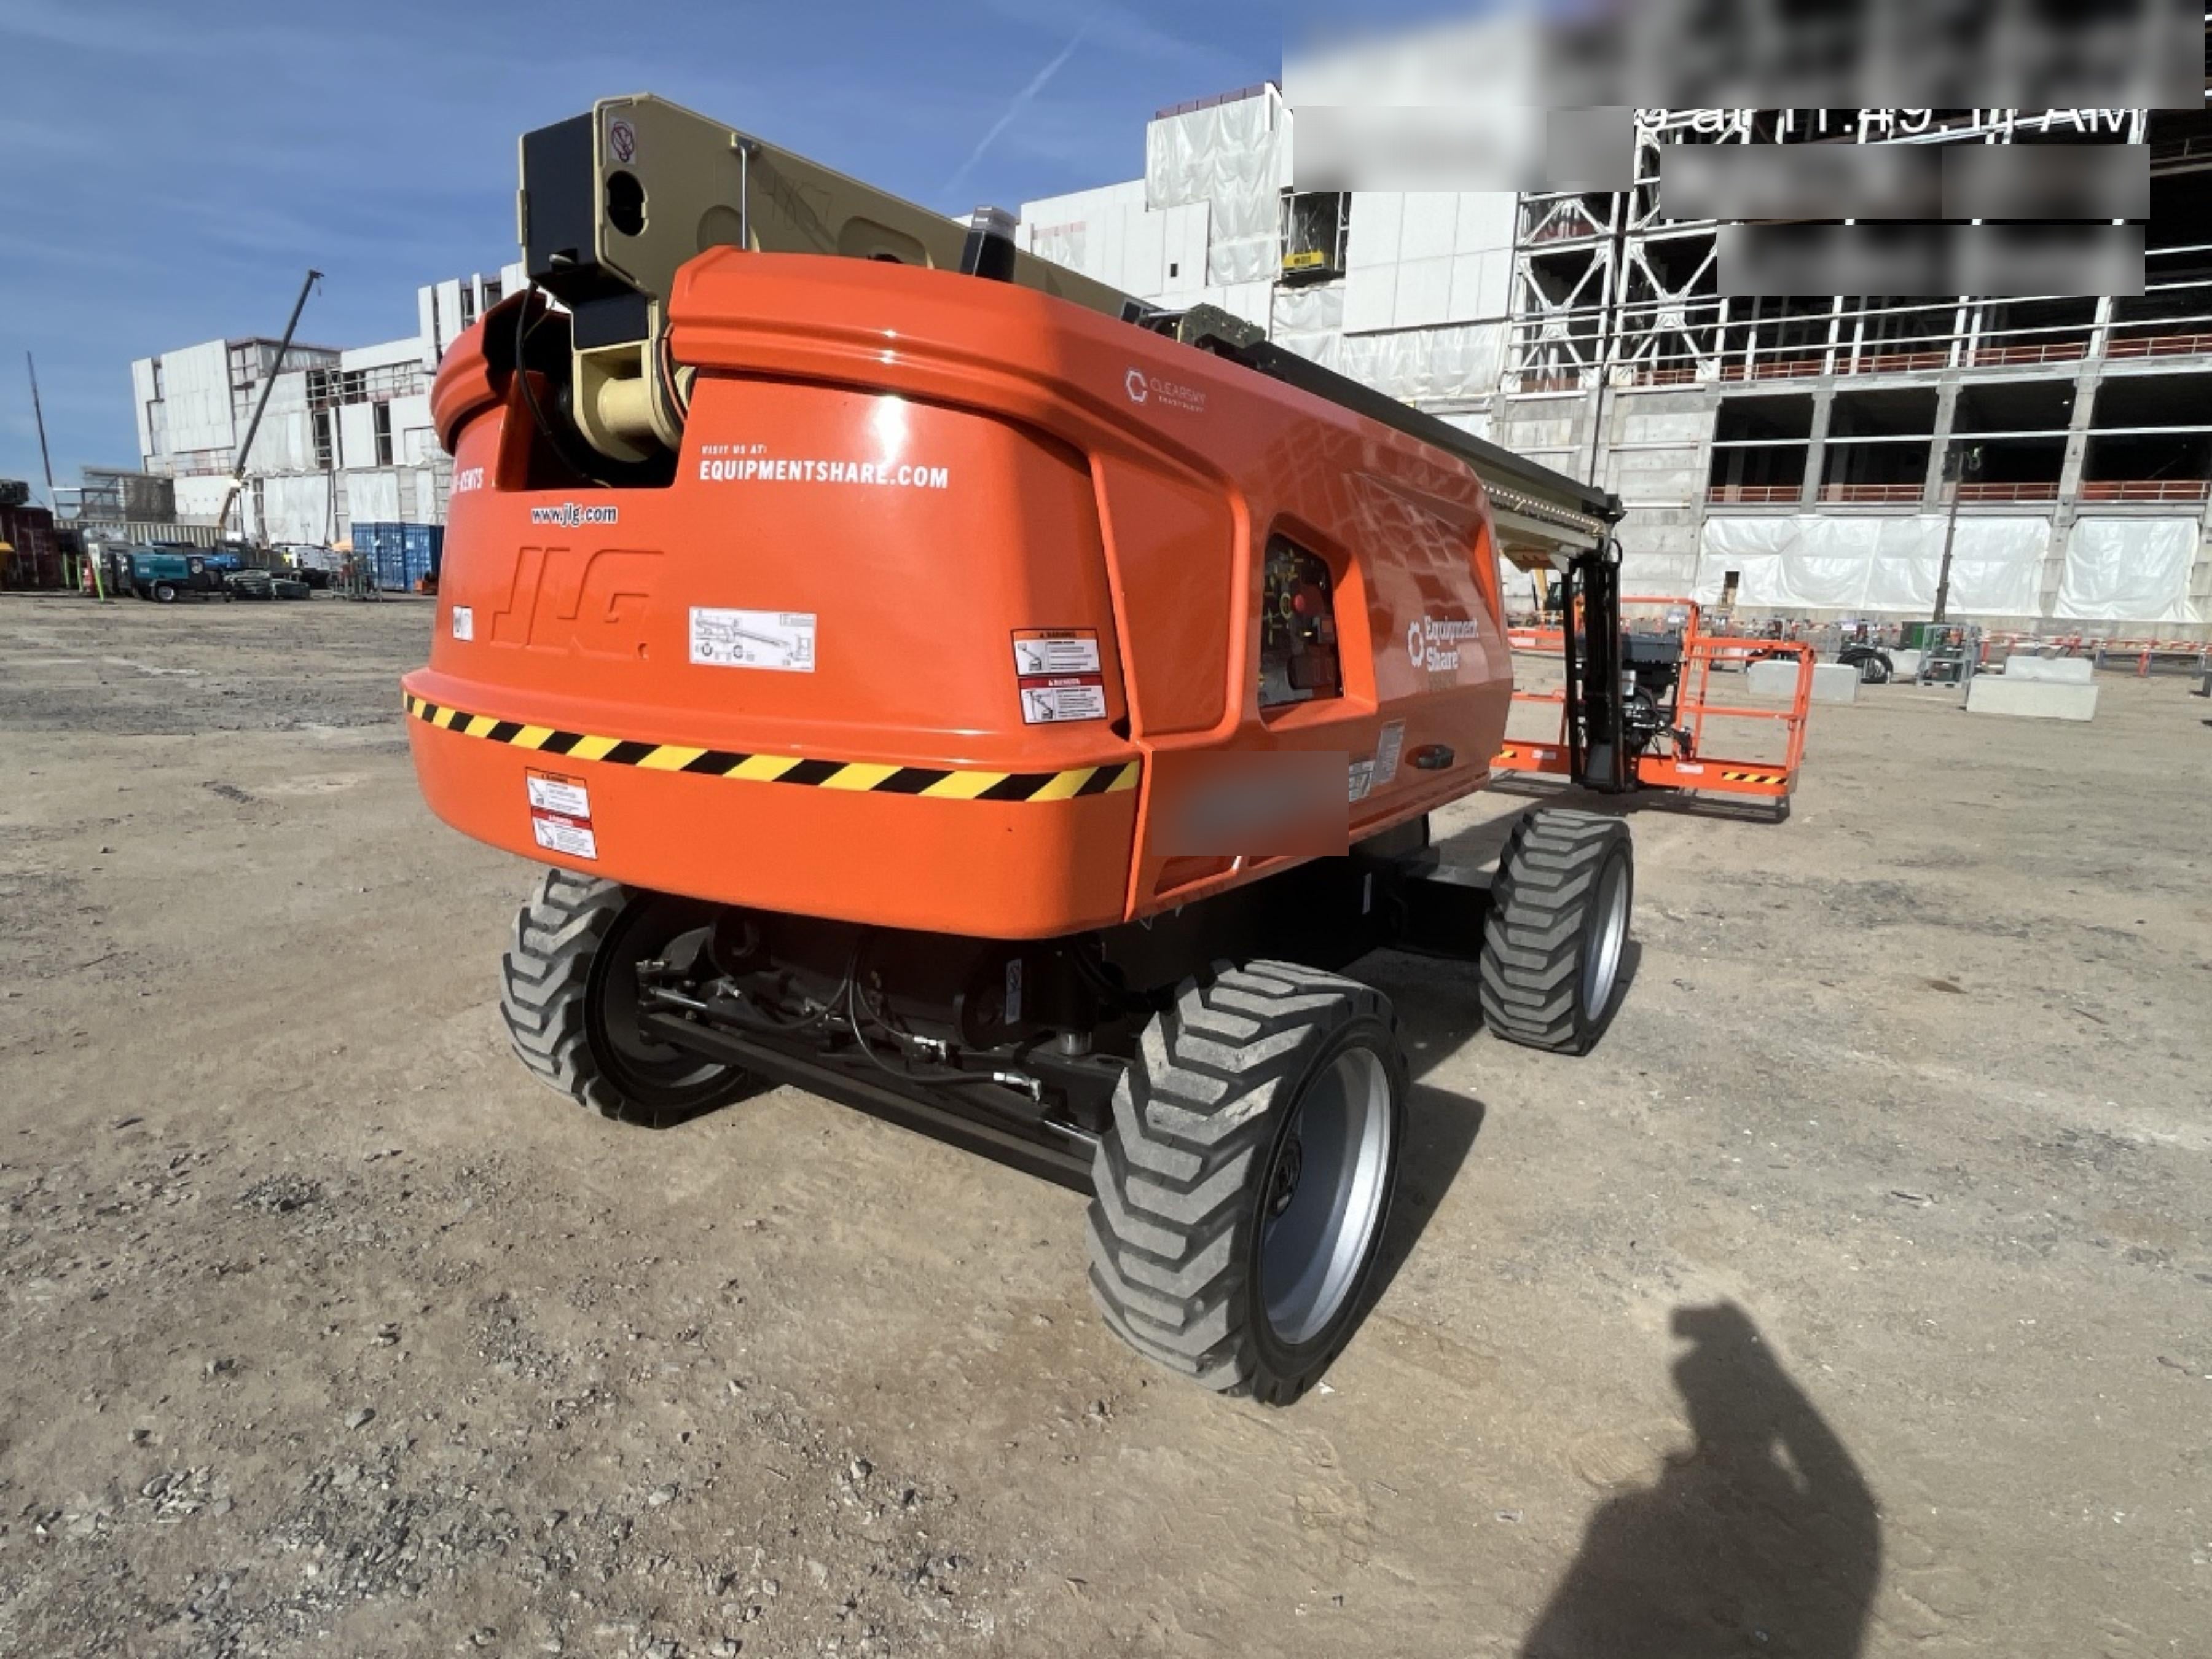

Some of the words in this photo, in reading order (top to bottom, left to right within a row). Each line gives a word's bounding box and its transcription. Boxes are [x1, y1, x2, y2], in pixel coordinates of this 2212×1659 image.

[702, 445, 728, 454] VISIT
[733, 445, 746, 454] US
[700, 460, 949, 489] EQUIPMENTSHARE.COM
[531, 503, 618, 527] www.jlg.com
[490, 546, 664, 660] JLG
[1424, 614, 1479, 646] Equipment
[1427, 646, 1459, 672] Share
